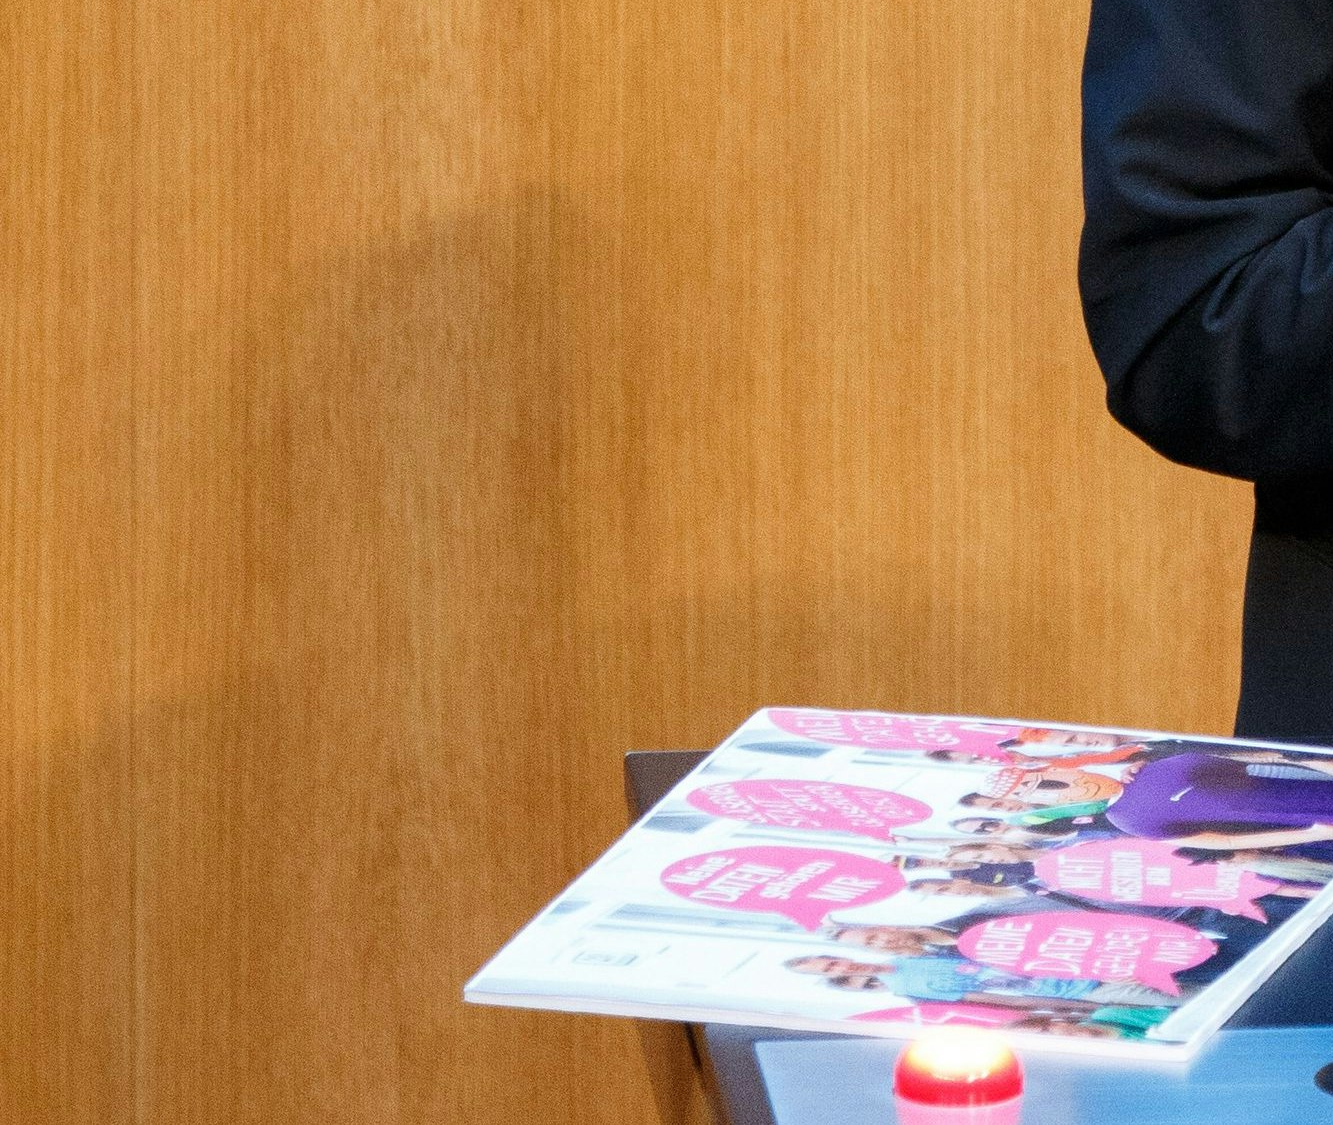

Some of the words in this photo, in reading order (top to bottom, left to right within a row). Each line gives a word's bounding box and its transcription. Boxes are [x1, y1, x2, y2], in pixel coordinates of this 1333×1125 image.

[688, 863, 786, 902] DATEN
[758, 861, 835, 898] gehören
[808, 877, 882, 901] MIR
[1058, 853, 1106, 888] NICHT
[975, 921, 1034, 966] MEINE
[1025, 928, 1093, 975] DATEN
